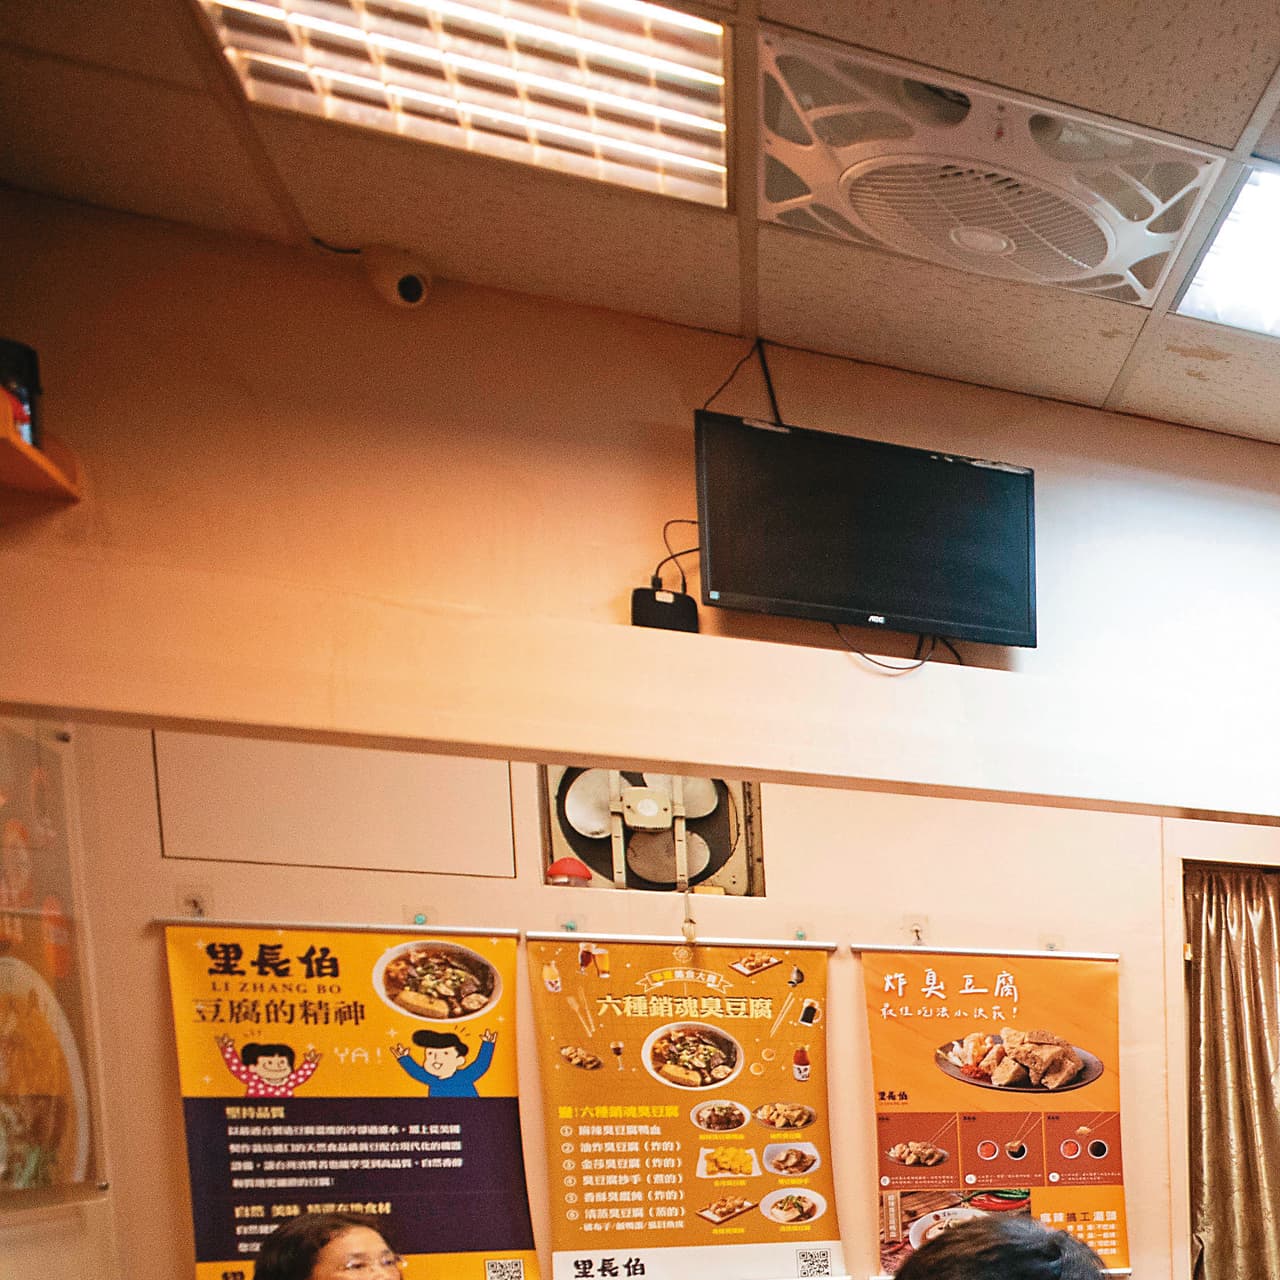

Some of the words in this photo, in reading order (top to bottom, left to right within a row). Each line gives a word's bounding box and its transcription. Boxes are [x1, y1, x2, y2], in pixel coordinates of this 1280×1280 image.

[205, 943, 341, 978] 里長伯
[211, 982, 232, 992] LI
[239, 982, 309, 994] ZHANG
[316, 984, 342, 994] BO
[883, 968, 1020, 1003] 炸臭豆腐
[193, 999, 366, 1026] 豆腐的精神
[596, 994, 773, 1019] 六種銷魂臭豆腐
[333, 1046, 383, 1065] YA!
[573, 1257, 646, 1279] 里長伯
